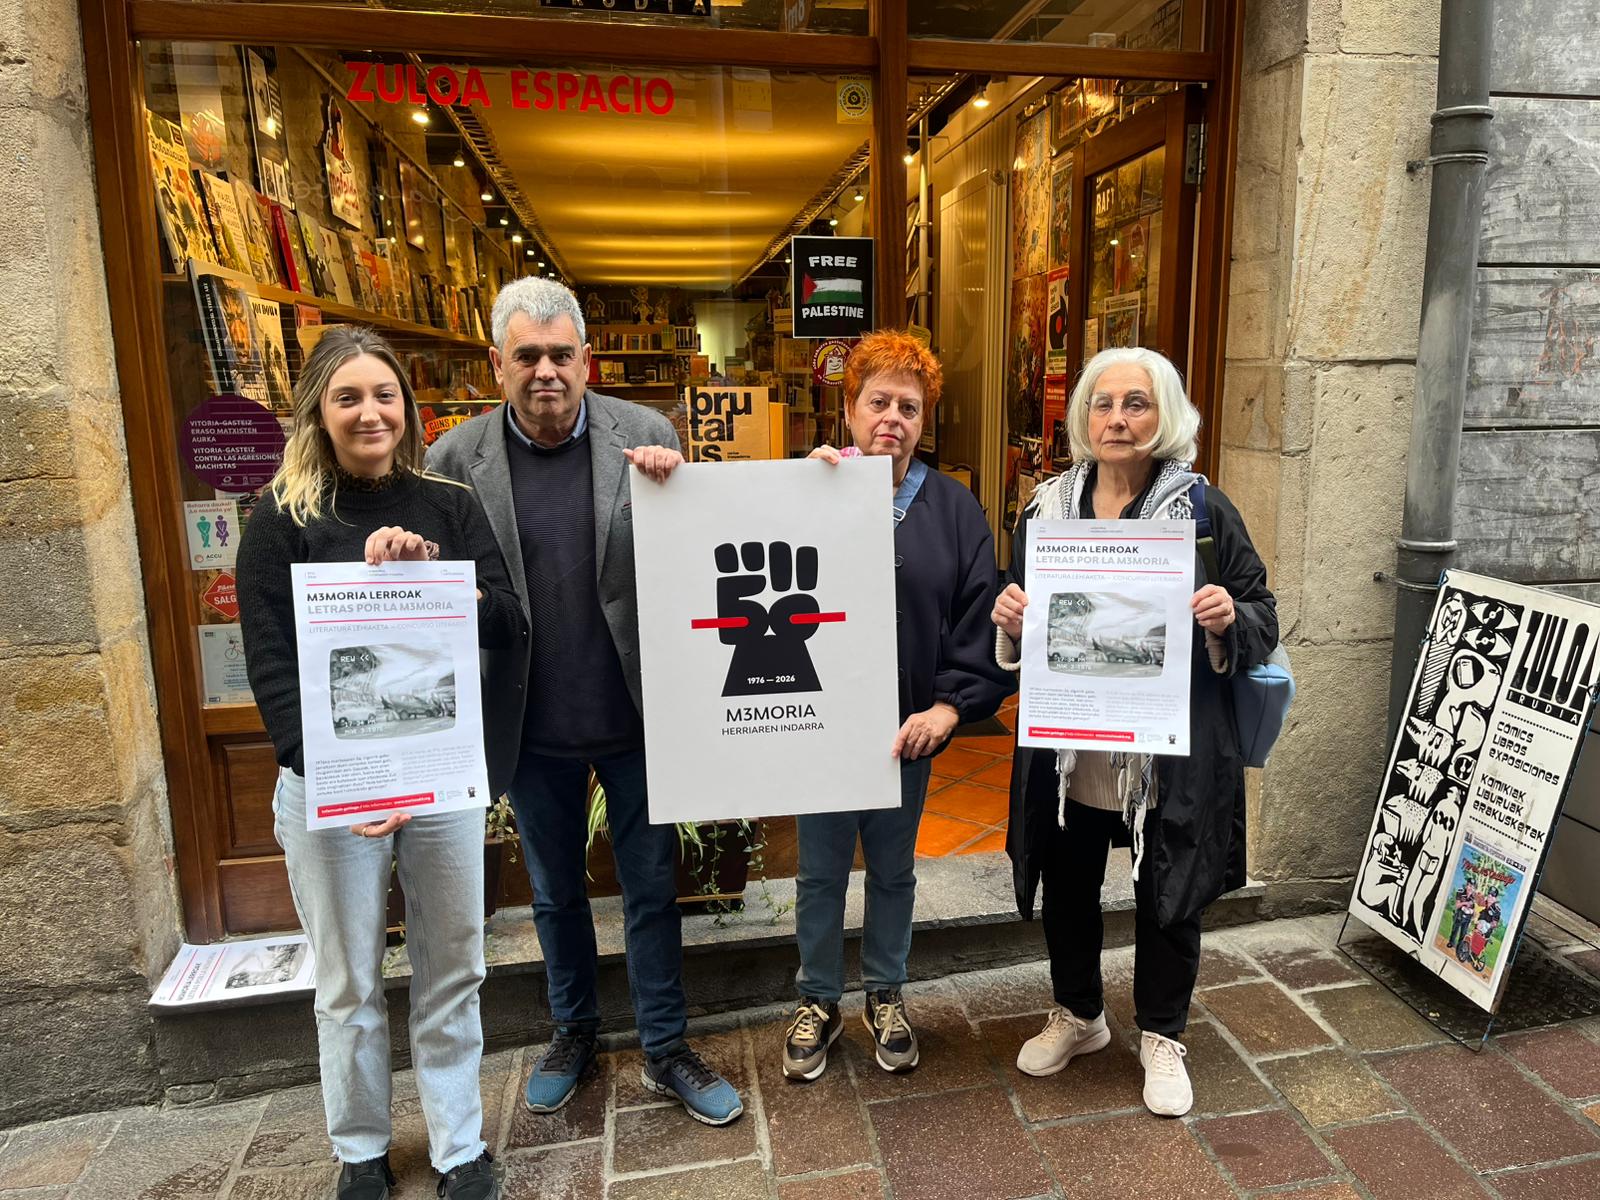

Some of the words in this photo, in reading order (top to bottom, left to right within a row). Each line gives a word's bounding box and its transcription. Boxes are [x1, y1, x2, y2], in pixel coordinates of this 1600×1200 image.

[345, 62, 492, 108] ZULOA
[511, 70, 674, 116] ESPACIO
[808, 255, 858, 268] FREE
[801, 305, 864, 319] PALESTINE
[690, 387, 752, 416] bru
[190, 419, 253, 427] VITORIA-GASTEIZ
[429, 418, 450, 431] GUNS
[689, 411, 734, 442] tal
[193, 446, 256, 454] VITORIA-GASTEIZ
[237, 453, 280, 461] AGRESIONES
[1036, 545, 1087, 553] M3MORIA
[1089, 545, 1139, 554] LERROAK
[1036, 555, 1074, 564] LETRAS
[1077, 555, 1100, 564] POR
[1101, 556, 1115, 565] LA
[1117, 556, 1170, 566] M3MORIA
[214, 594, 237, 605] SALG
[307, 591, 367, 602] M3MORIA
[370, 589, 422, 600] LERROAK
[308, 604, 354, 615] LETRAS
[356, 603, 381, 613] POR
[383, 602, 398, 612] LA
[399, 601, 454, 612] M3MORIA
[340, 655, 356, 663] REW
[775, 675, 796, 683] 2026
[726, 704, 816, 722] M3MORIA
[1508, 690, 1578, 724] IRUDIA
[722, 725, 778, 736] HERRIAREN
[780, 722, 824, 732] INDARRA
